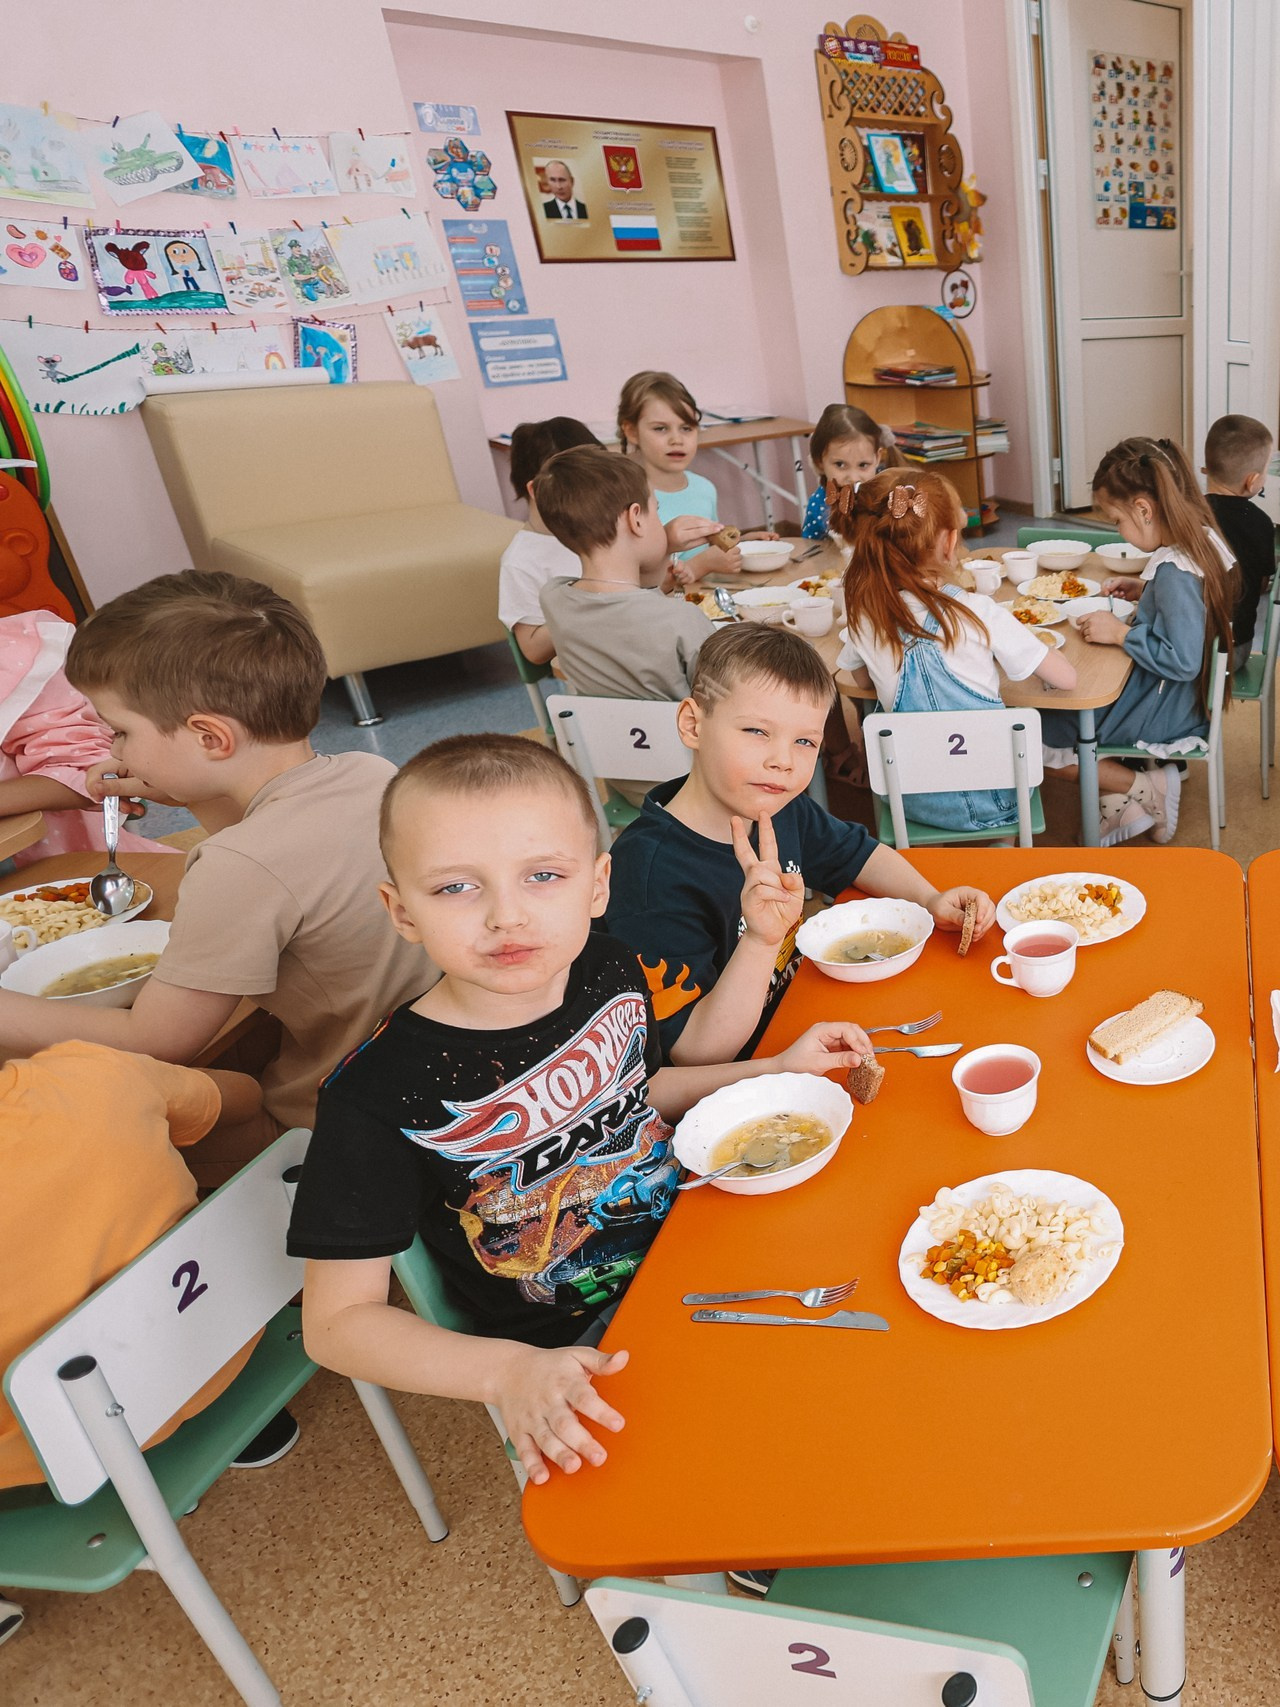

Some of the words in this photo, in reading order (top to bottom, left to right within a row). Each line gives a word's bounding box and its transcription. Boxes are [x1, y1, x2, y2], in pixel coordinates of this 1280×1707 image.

[795, 460, 803, 472] 2
[630, 728, 650, 749] 2
[948, 734, 967, 755] 2
[518, 1055, 594, 1139] HOT
[172, 1260, 208, 1314] 2
[788, 1642, 837, 1679] 2
